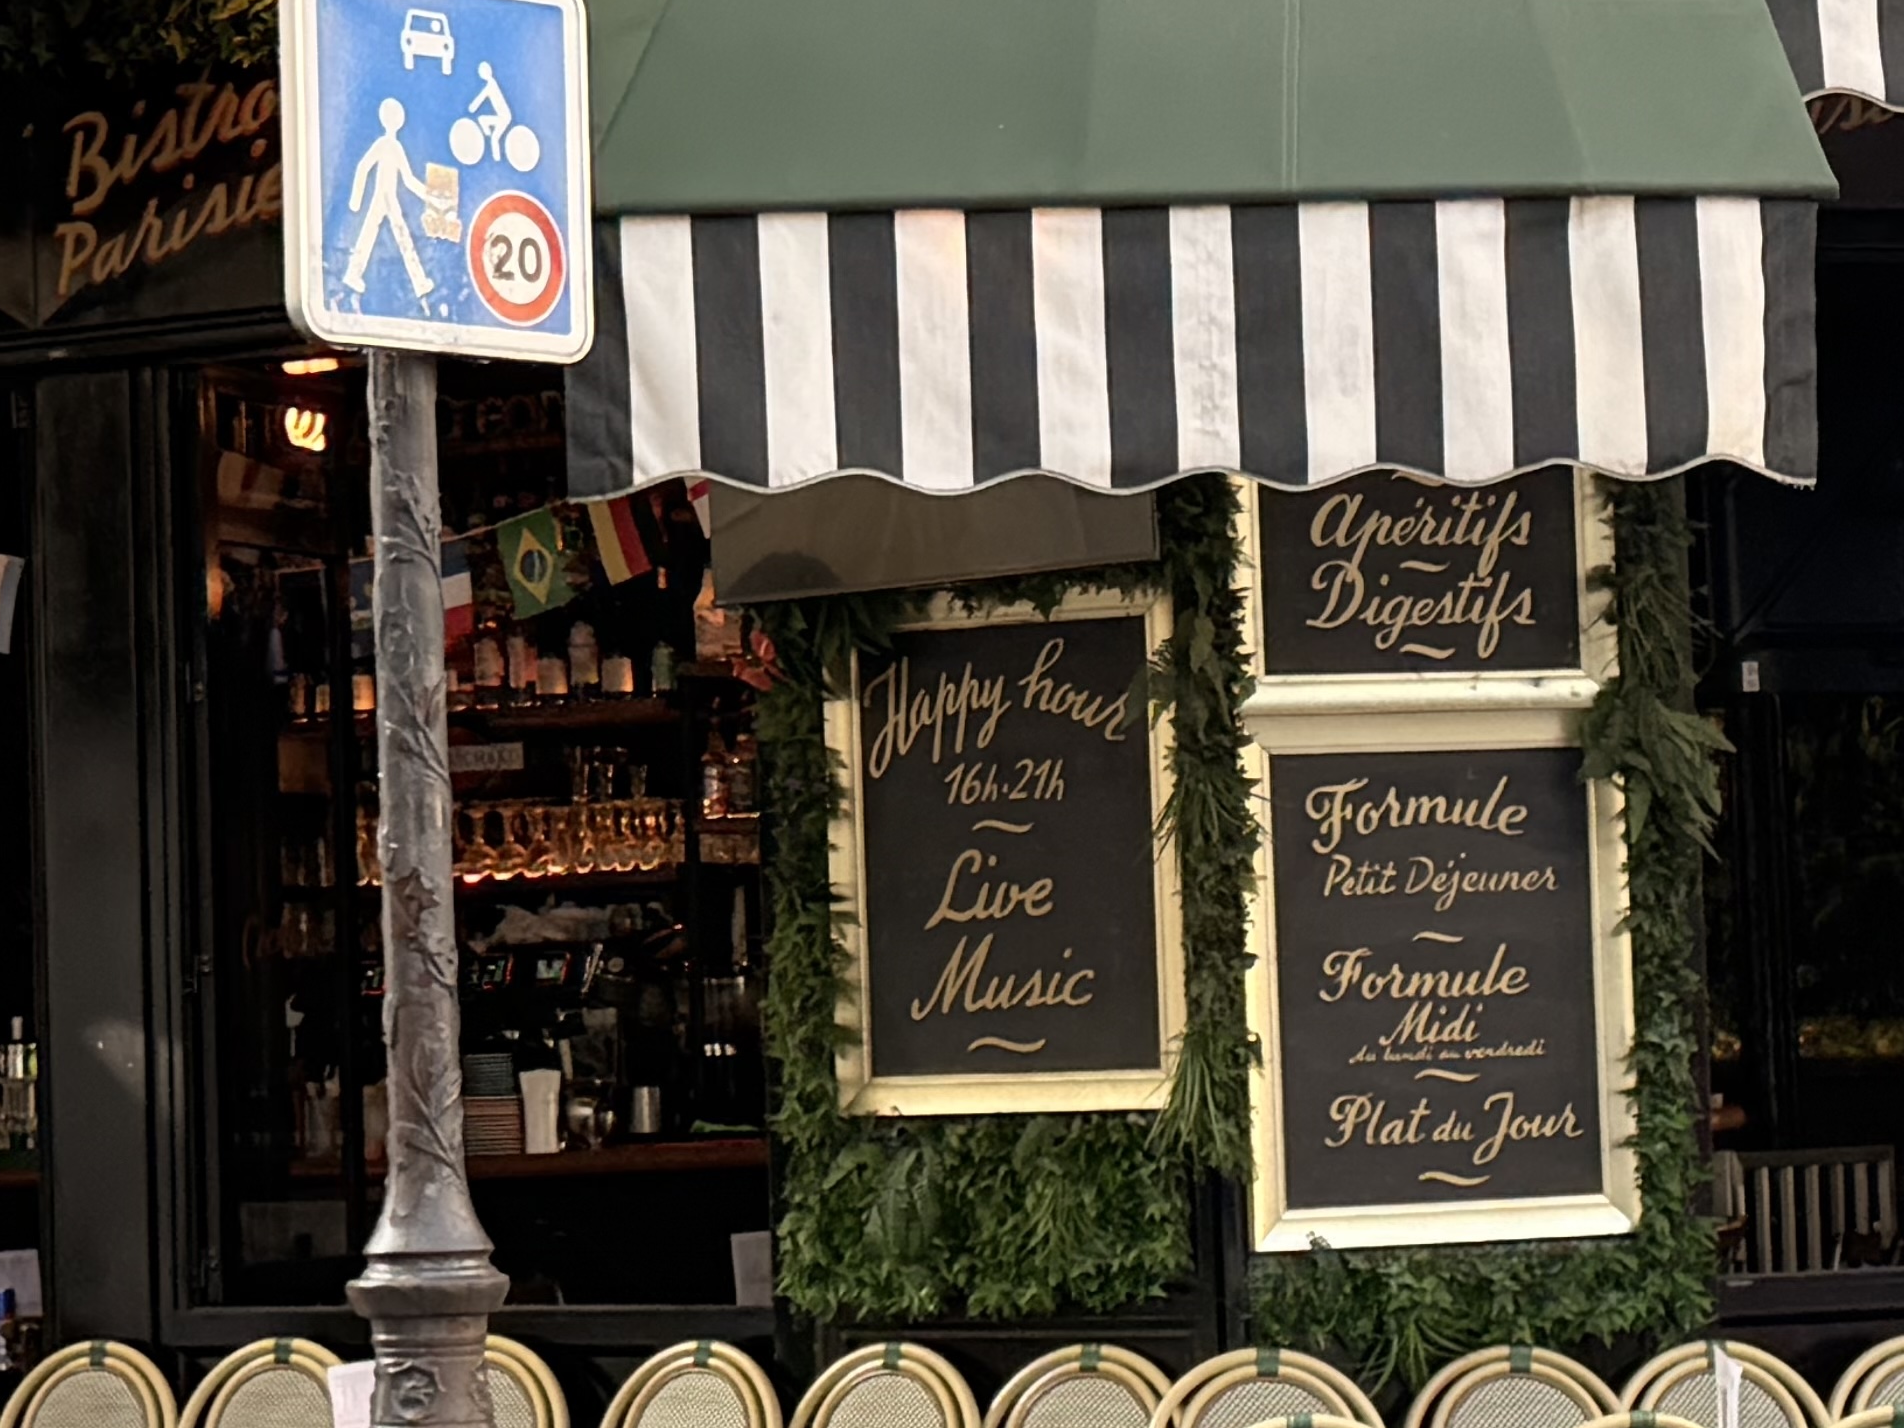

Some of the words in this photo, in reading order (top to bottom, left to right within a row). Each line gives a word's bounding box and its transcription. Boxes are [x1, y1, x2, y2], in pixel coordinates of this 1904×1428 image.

[53, 139, 283, 300] Parisie
[490, 233, 543, 282] 20
[1306, 559, 1536, 659] Digestifs
[863, 655, 1012, 779] Happy
[1018, 637, 1130, 741] hour
[1305, 775, 1529, 855] Formule
[924, 848, 1055, 931] Live
[1323, 854, 1397, 897] Petit
[1405, 852, 1559, 912] Déjeuner
[910, 933, 1095, 1022] Music
[1319, 943, 1530, 1003] Formule
[1349, 1045, 1377, 1064] du
[1383, 1045, 1434, 1062] lundi
[1465, 1038, 1546, 1059] vendredi
[1379, 1001, 1484, 1046] Midi
[1324, 1092, 1431, 1148] Plat
[1432, 1109, 1474, 1141] du
[1472, 1091, 1584, 1166] Jour
